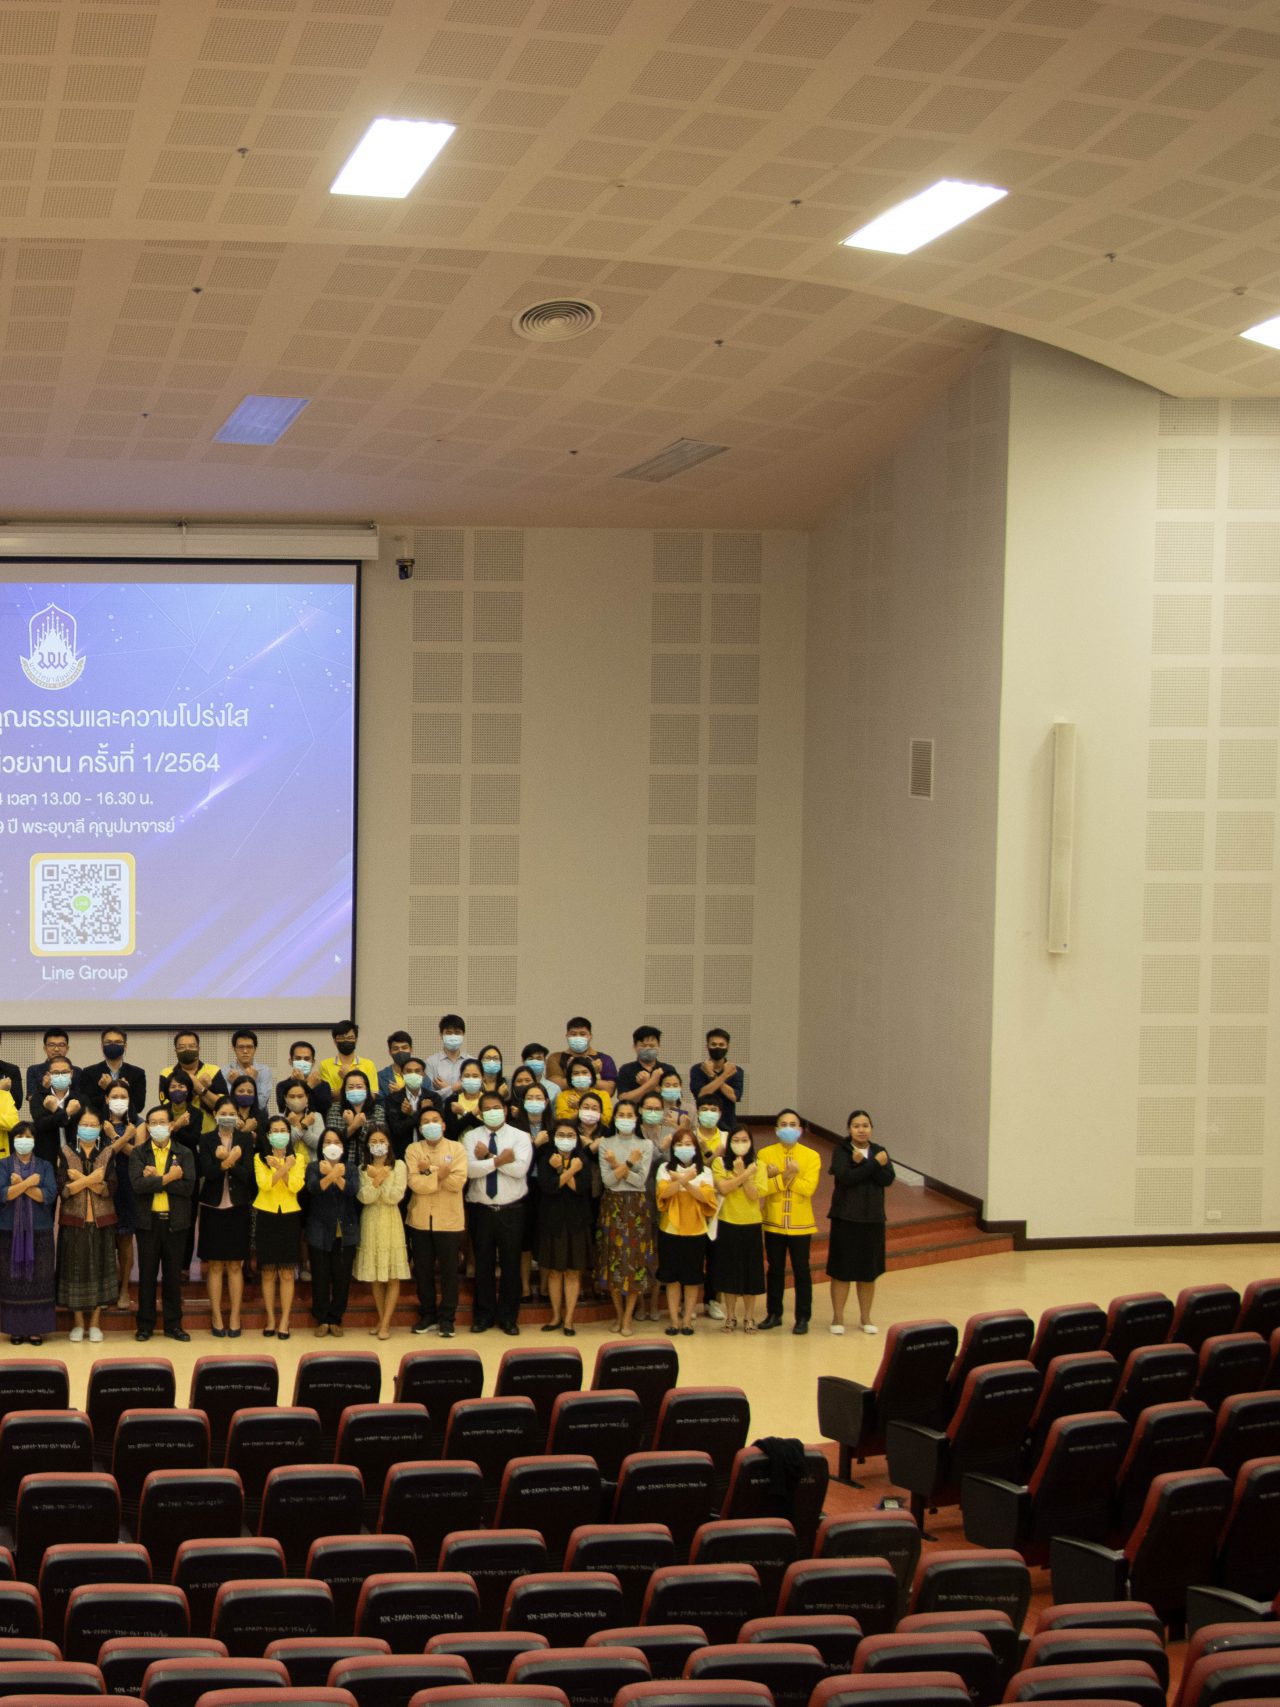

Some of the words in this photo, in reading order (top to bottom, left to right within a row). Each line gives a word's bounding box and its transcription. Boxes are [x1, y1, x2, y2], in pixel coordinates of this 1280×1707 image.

[78, 743, 135, 773] ครั้งที่
[142, 752, 221, 773] 1/2564
[7, 793, 38, 806] เวลา
[41, 791, 82, 806] 13.00
[96, 791, 137, 806] 16.30
[140, 793, 154, 806] น.
[7, 817, 19, 834] ปี
[22, 817, 85, 838] พระอุบาลี
[42, 965, 75, 981] Line
[78, 965, 129, 983] Group
